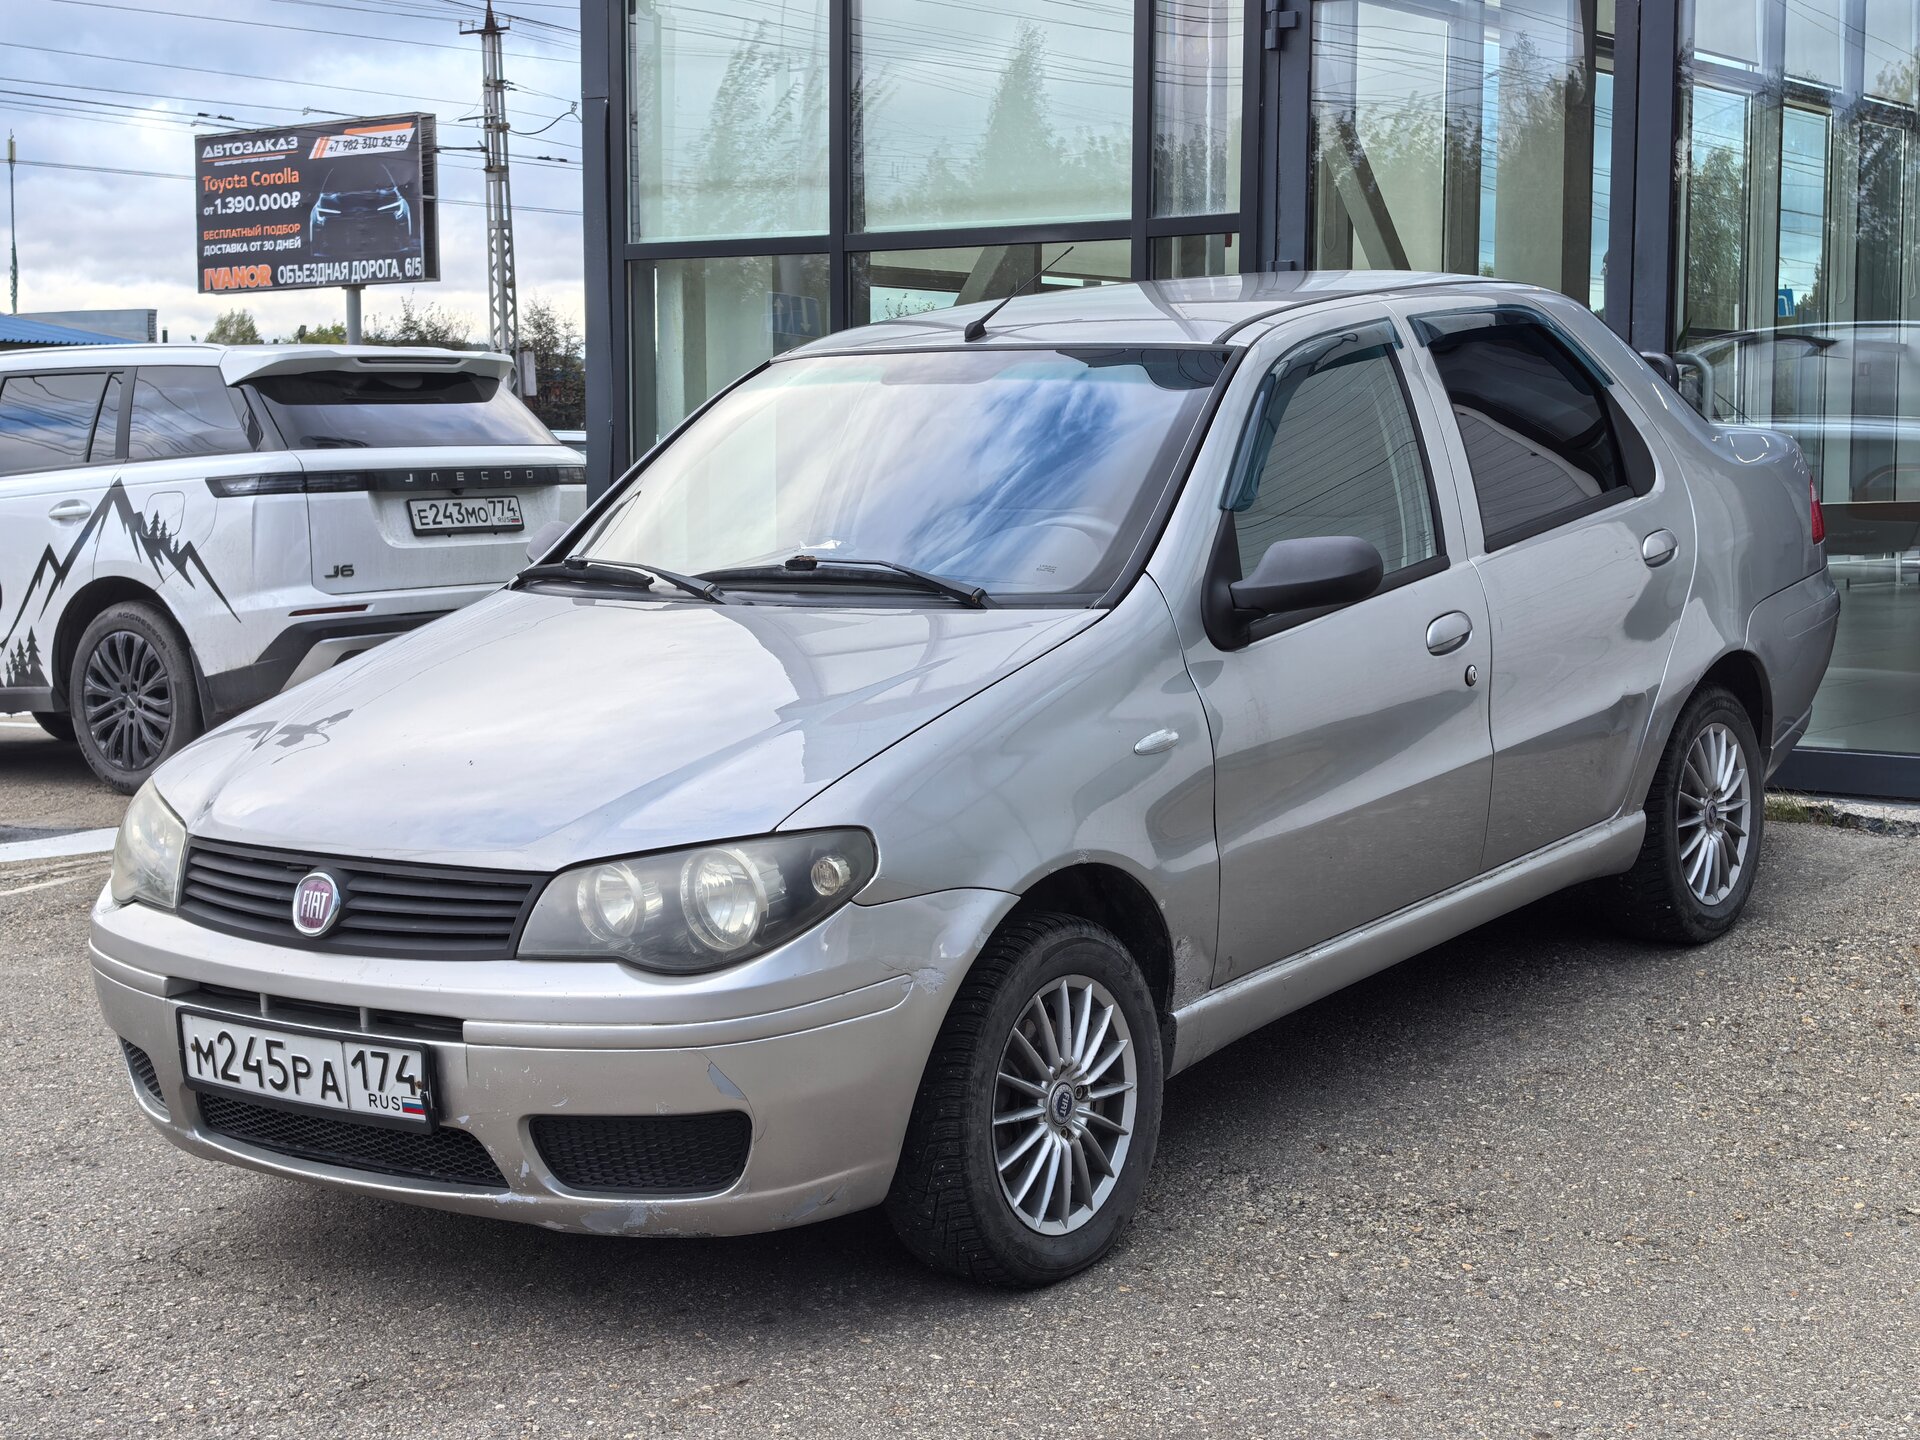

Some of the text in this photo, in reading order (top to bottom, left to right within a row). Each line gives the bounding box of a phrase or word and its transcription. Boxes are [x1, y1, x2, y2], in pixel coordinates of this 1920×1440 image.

[202, 136, 299, 158] АВТОЗАКАЗ
[202, 167, 300, 194] Toyota Corolla
[203, 191, 301, 216] от 1.390.000₽
[203, 223, 301, 241] БЕСПЛАТНЫЙ ПОДБОР
[203, 236, 302, 257] ДОСТАВКА ОТ 30 ДНЕЙ
[203, 264, 273, 291] IVANOR
[277, 256, 422, 285] ОБЪЕЗДНАЯ ДОРОГА, 6/5
[488, 499, 517, 517] 774
[324, 564, 355, 579] J6
[116, 611, 168, 650] AGGRESSOR
[300, 889, 330, 920] FIAT
[350, 1049, 417, 1096] 174
[368, 1092, 401, 1111] RUS
[1060, 1092, 1070, 1117] FIAT
